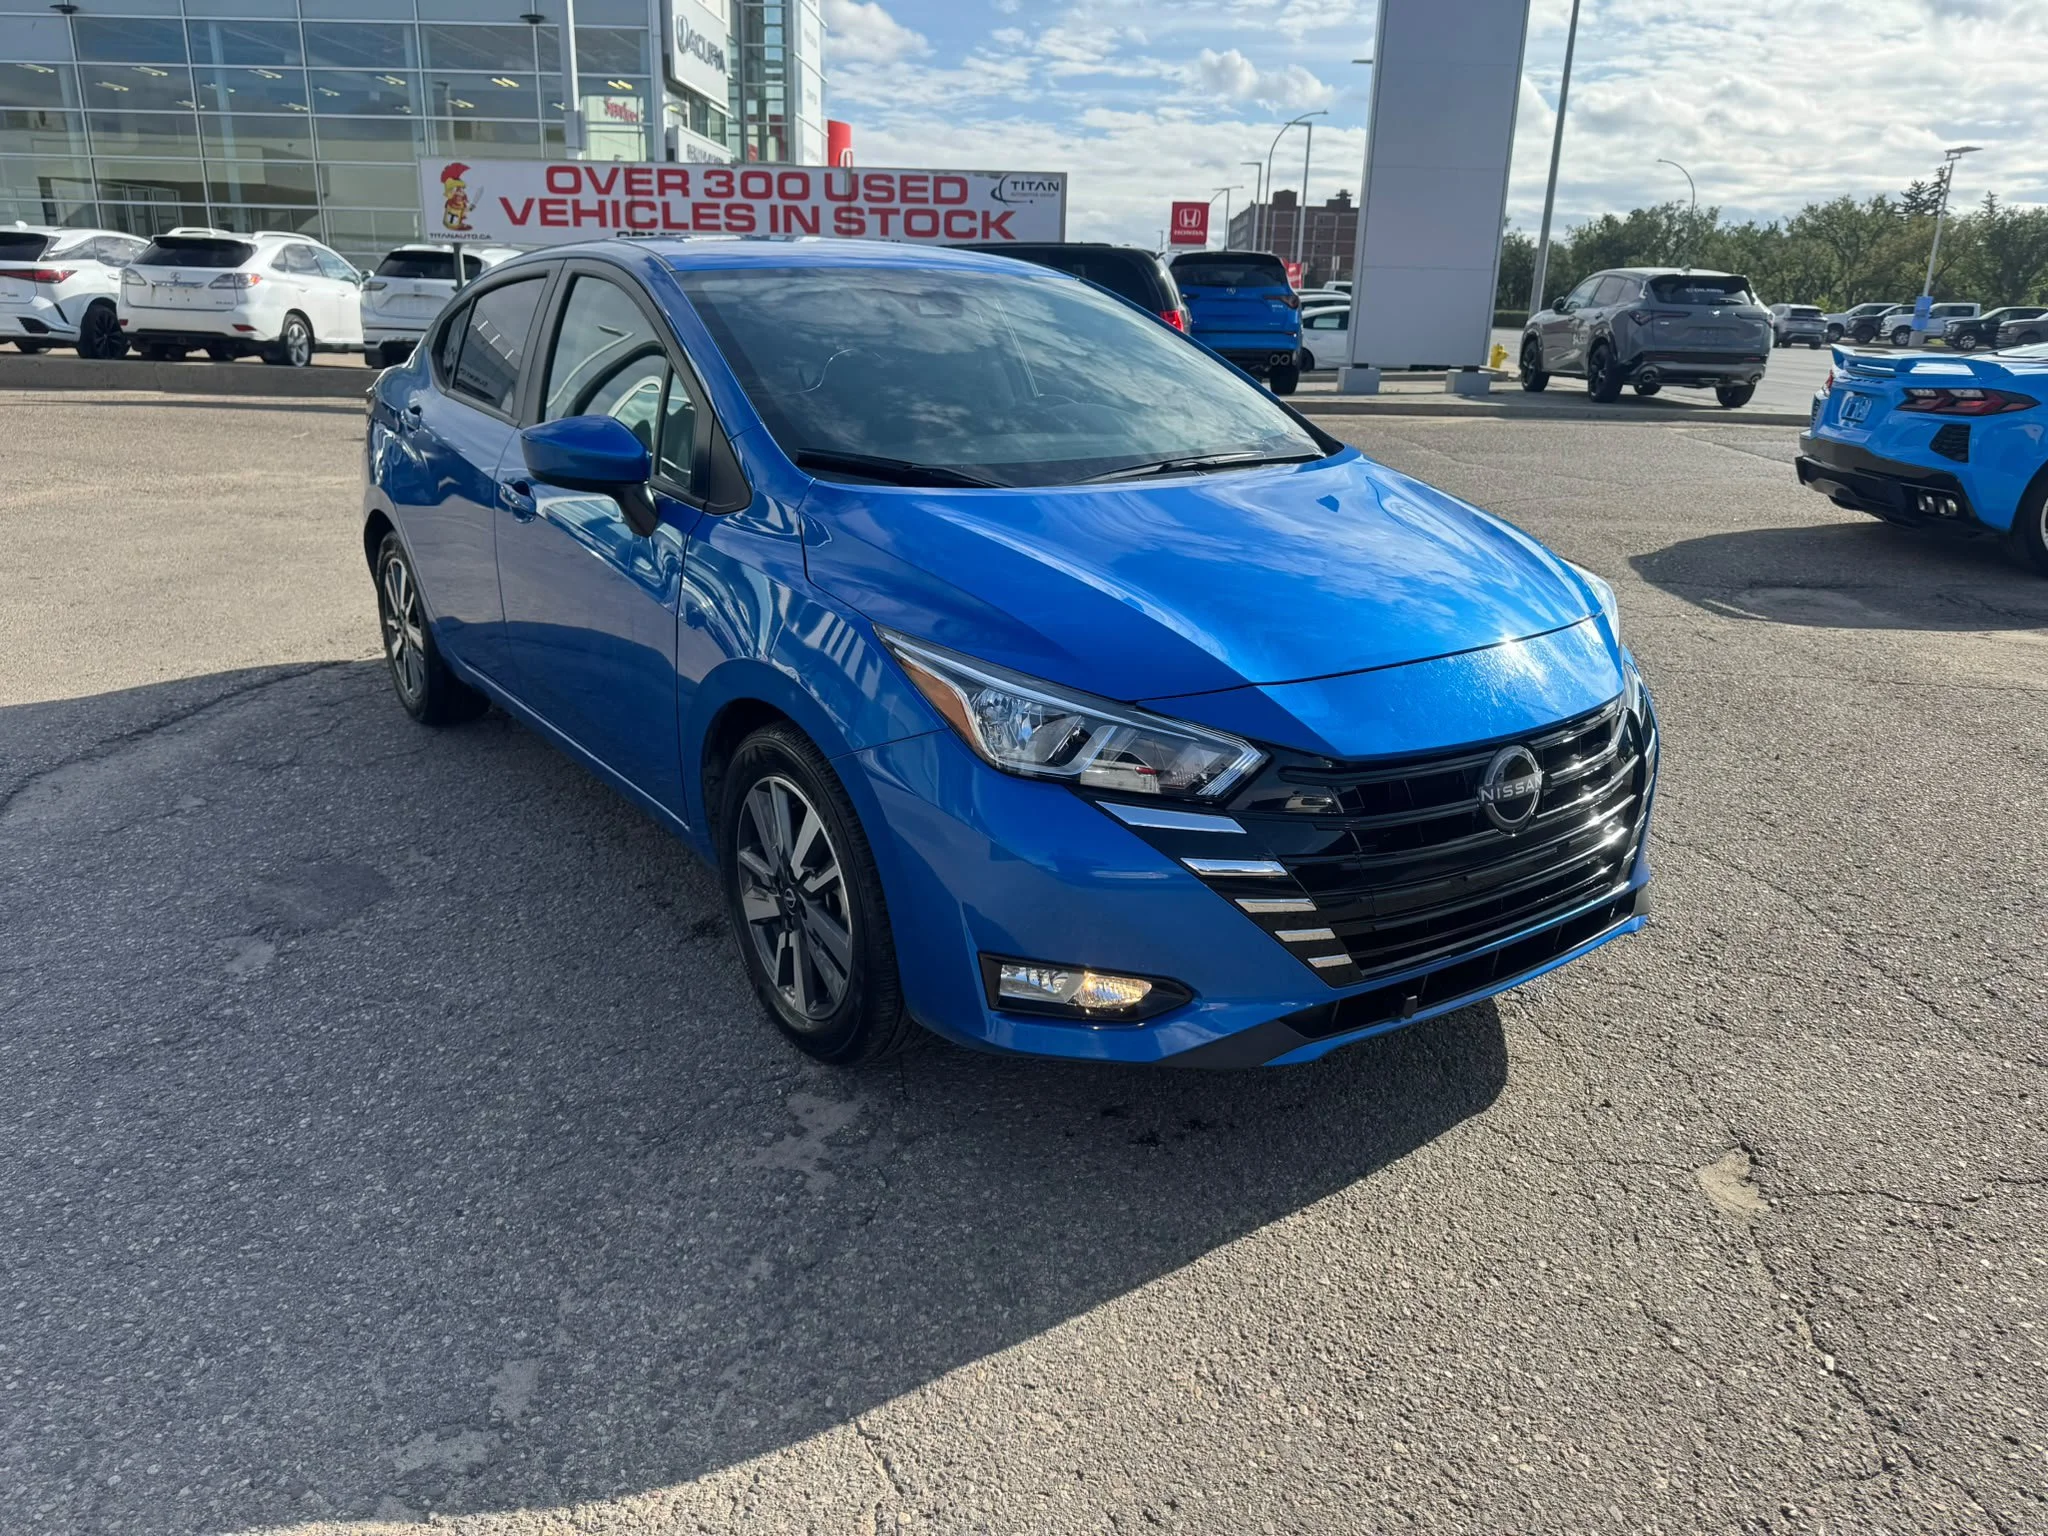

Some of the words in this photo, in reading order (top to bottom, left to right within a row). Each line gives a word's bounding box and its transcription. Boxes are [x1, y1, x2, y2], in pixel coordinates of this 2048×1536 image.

[688, 28, 726, 75] ACURA
[546, 165, 691, 199] OVER
[703, 169, 811, 201] 300
[824, 172, 969, 205] USED
[1010, 180, 1060, 192] TITAN
[499, 196, 757, 233] VEHICLES
[769, 203, 821, 235] IN
[833, 206, 1016, 241] STOCK
[429, 232, 493, 241] TITANAUTO.CA
[1173, 229, 1205, 237] HONDA
[1480, 775, 1541, 802] NISSAN
